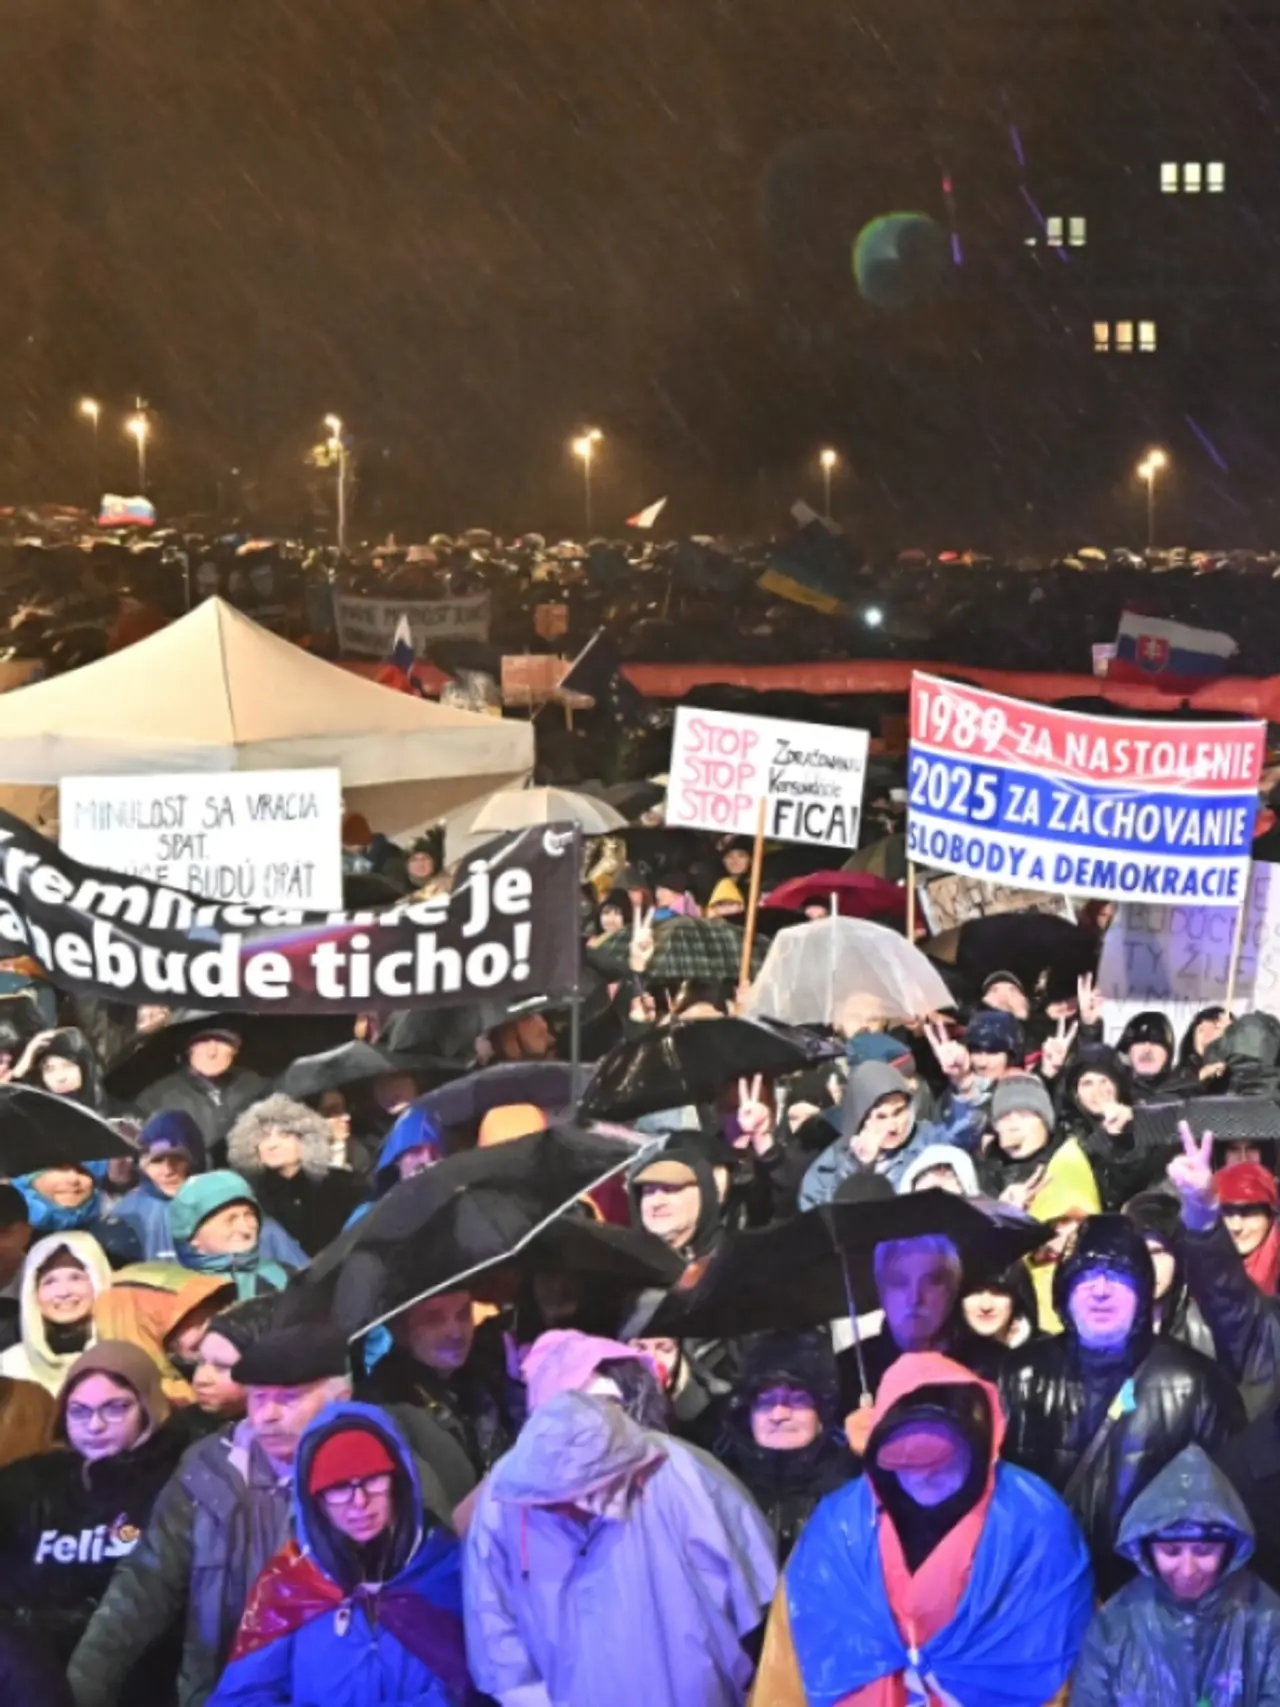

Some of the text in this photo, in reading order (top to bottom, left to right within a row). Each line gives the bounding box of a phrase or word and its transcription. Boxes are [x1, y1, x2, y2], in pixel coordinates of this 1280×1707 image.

[681, 754, 756, 792] STOP
[684, 718, 759, 760] STOP
[916, 690, 1256, 780] 1989 ZA NASTOLENIE
[202, 796, 234, 829] SA
[677, 789, 753, 826] STOP
[912, 758, 1247, 846] 2025 ZA ZACHOVANIE
[908, 821, 1027, 877] SLOBODY
[1028, 855, 1047, 881] A
[1053, 853, 1240, 898] DEMOKRACIE
[462, 859, 533, 938] je
[310, 921, 532, 999] ticho!
